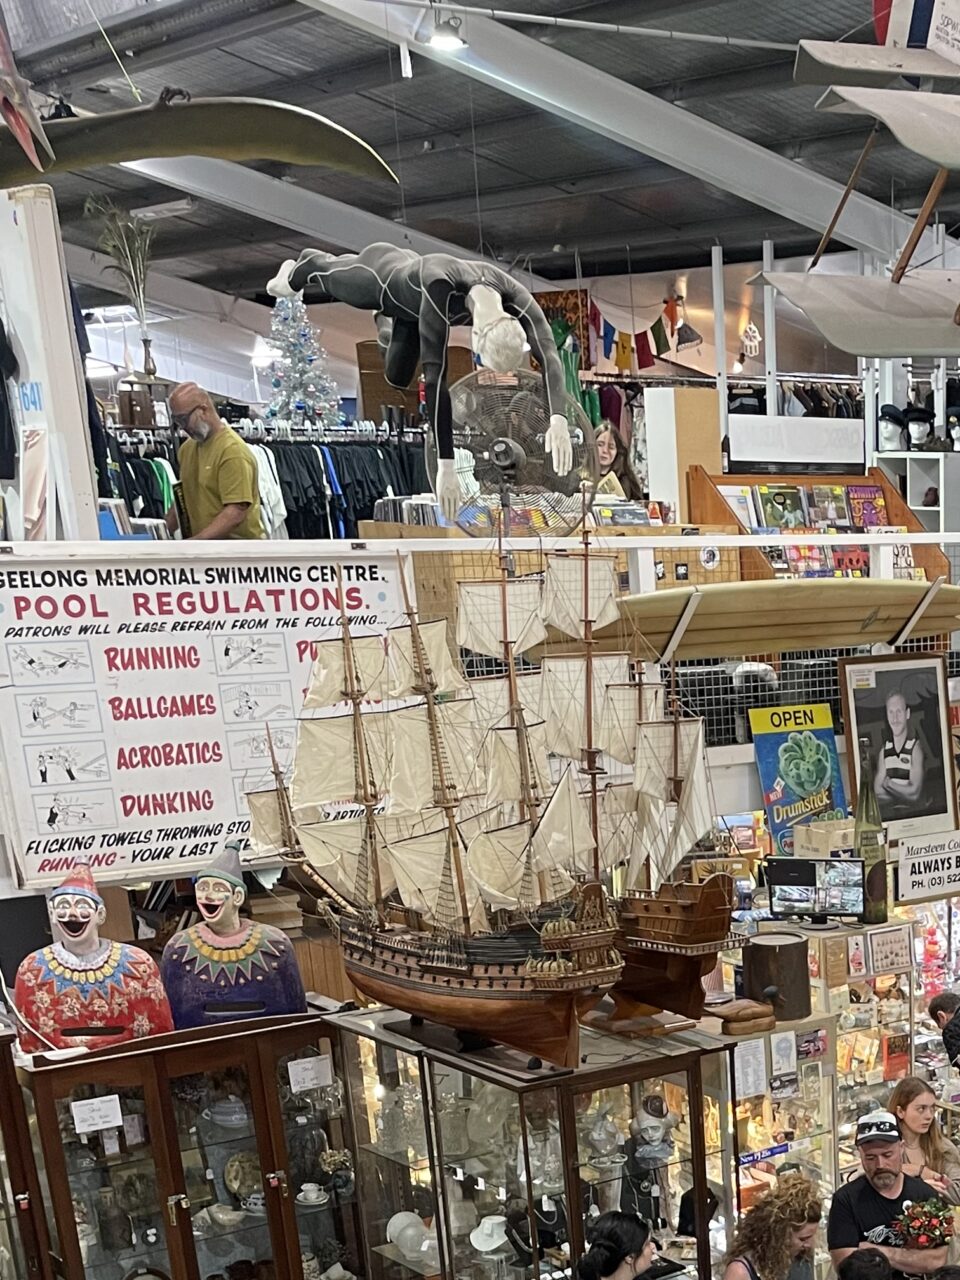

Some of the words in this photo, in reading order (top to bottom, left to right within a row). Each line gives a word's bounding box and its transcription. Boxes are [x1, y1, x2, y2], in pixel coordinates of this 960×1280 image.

[95, 567, 201, 587] MEMORIAL
[13, 593, 109, 620] POOL
[132, 587, 371, 617] REGULATIONS.
[4, 624, 72, 639] PATRONS
[78, 623, 111, 636] WILL
[117, 621, 168, 634] PLEASE
[170, 619, 227, 633] REFRAIN
[231, 618, 269, 630] FROM
[276, 617, 300, 629] THE
[104, 645, 201, 672] RUNNING
[108, 693, 217, 721] BALLGAMES
[770, 709, 815, 728] OPEN
[117, 741, 223, 770] ACROBATICS
[120, 789, 214, 817] DUNKING
[772, 788, 831, 824] Drumstick
[100, 829, 153, 848] TOWELS
[156, 820, 224, 842] THROWING
[130, 846, 175, 864] YOUR
[179, 841, 219, 858] LAST
[905, 842, 946, 857] Marsteen
[910, 857, 951, 876] ALWAYS
[911, 879, 926, 890] PH.
[927, 876, 945, 889] (03)
